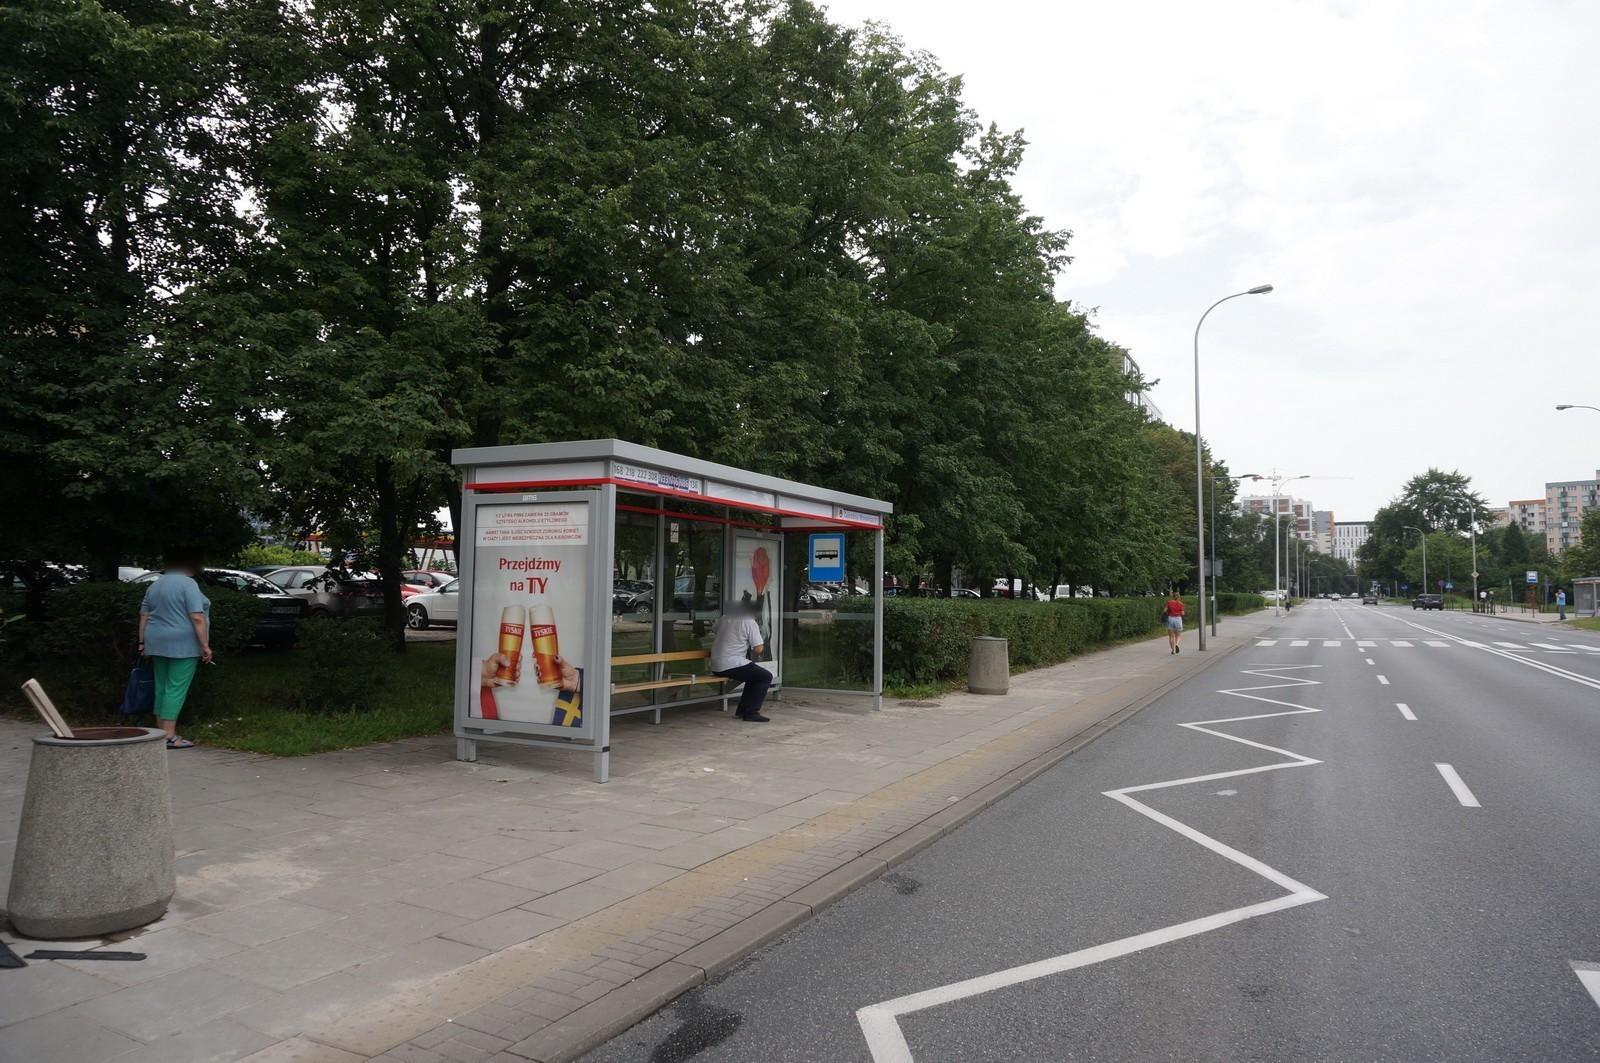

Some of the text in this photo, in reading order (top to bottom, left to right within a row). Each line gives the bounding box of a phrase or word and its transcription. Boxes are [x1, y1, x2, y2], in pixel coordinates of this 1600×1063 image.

[499, 556, 561, 572] Przejdźmy
[510, 577, 548, 594] na TY
[505, 626, 522, 635] TYSKIE
[534, 626, 553, 637] TYSKIE
